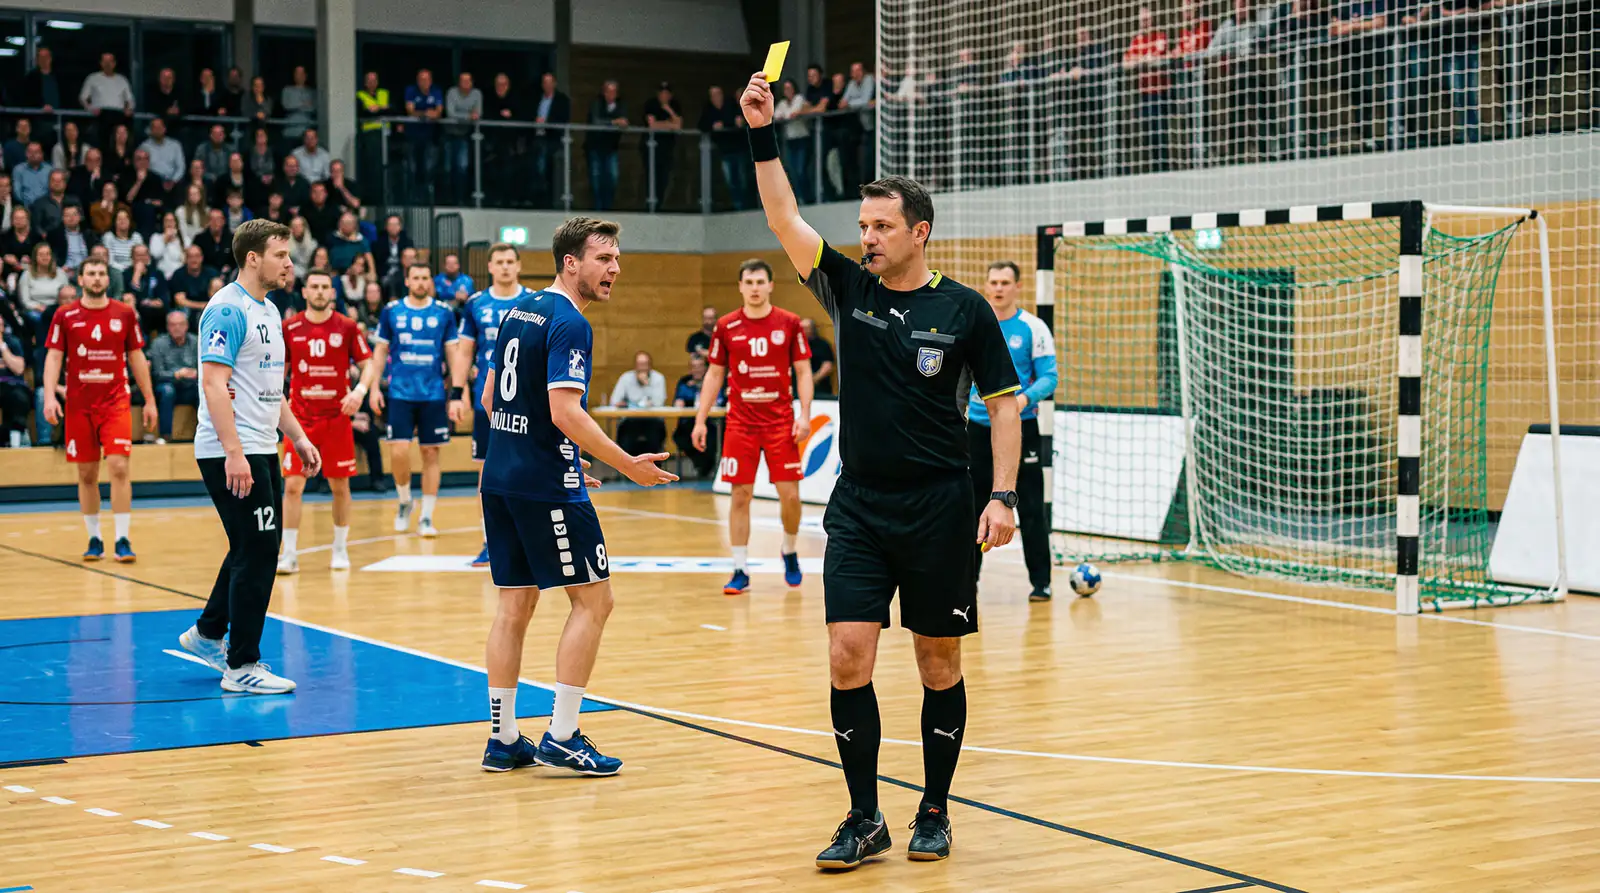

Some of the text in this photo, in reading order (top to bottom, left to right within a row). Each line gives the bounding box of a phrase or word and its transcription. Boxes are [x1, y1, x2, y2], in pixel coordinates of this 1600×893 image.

[91, 324, 102, 342] 4
[256, 323, 271, 345] 12
[308, 338, 326, 358] 10
[748, 336, 768, 357] 10
[500, 337, 520, 402] 8
[490, 407, 529, 435] MÜLLER
[67, 438, 77, 458] 4
[720, 456, 738, 477] 10
[253, 505, 276, 532] 12
[595, 543, 608, 571] 8
